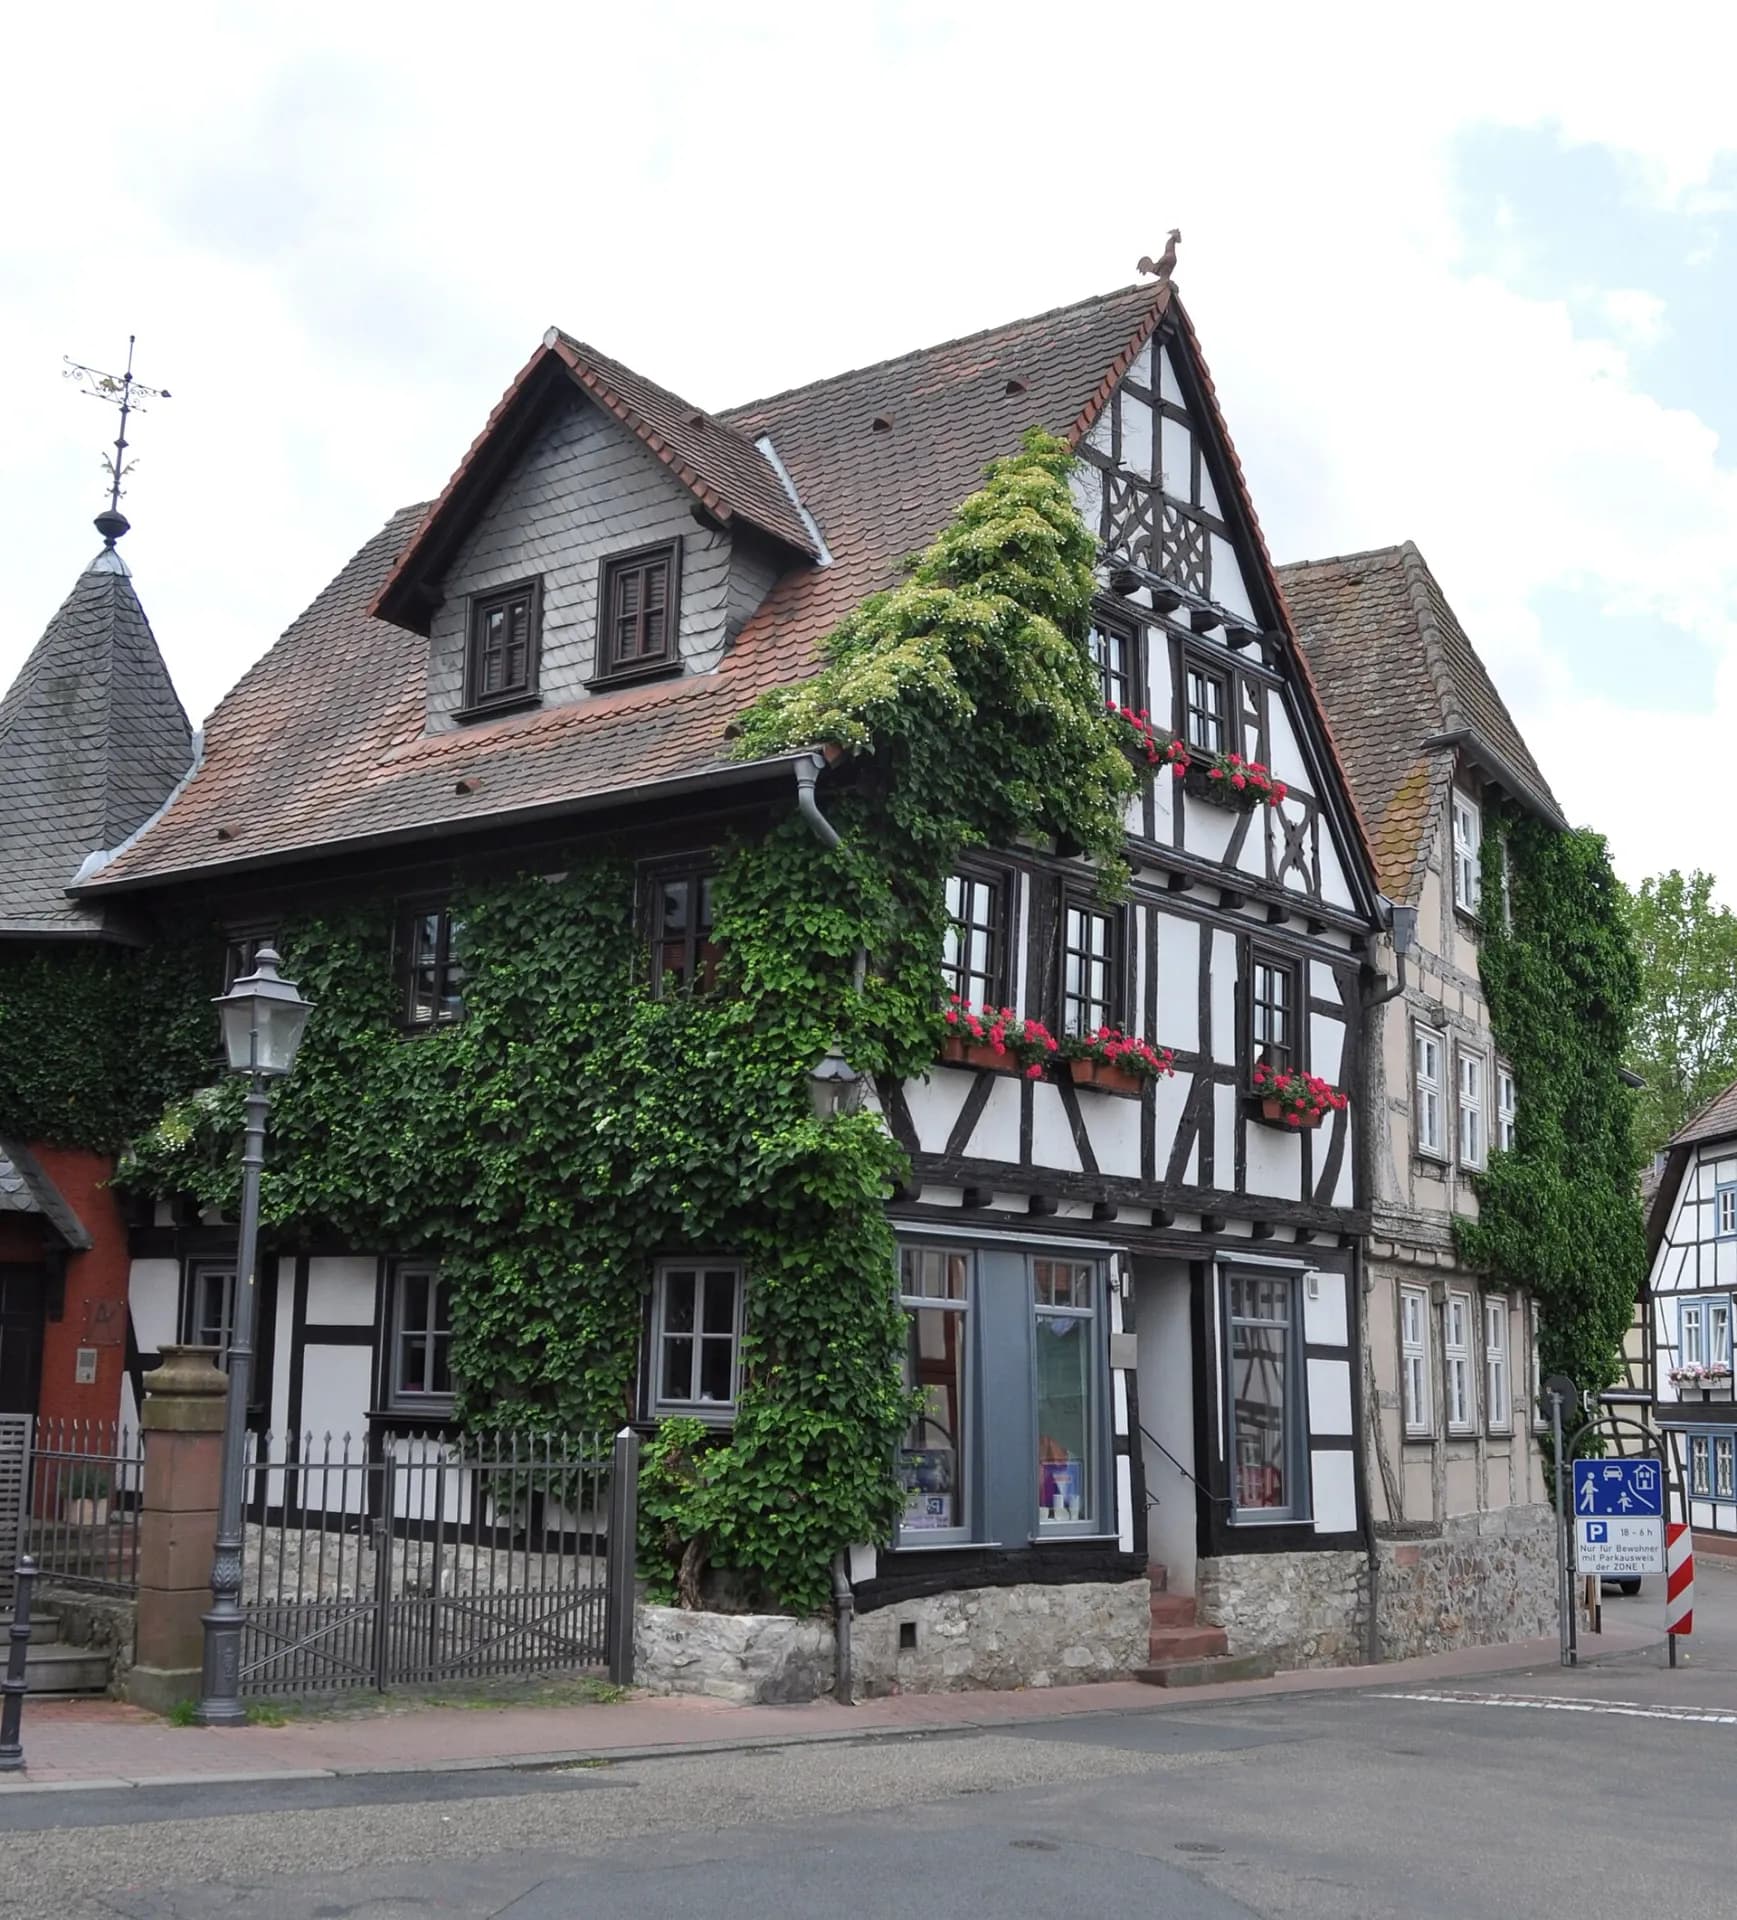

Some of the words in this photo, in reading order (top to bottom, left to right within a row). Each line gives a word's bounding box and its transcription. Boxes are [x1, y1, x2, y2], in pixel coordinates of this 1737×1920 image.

[1590, 1524, 1603, 1541] P
[1620, 1528, 1630, 1537] 18
[1639, 1528, 1645, 1537] 6
[1647, 1528, 1653, 1537] h
[1595, 1563, 1610, 1571] der
[1614, 1563, 1638, 1571] ZONE
